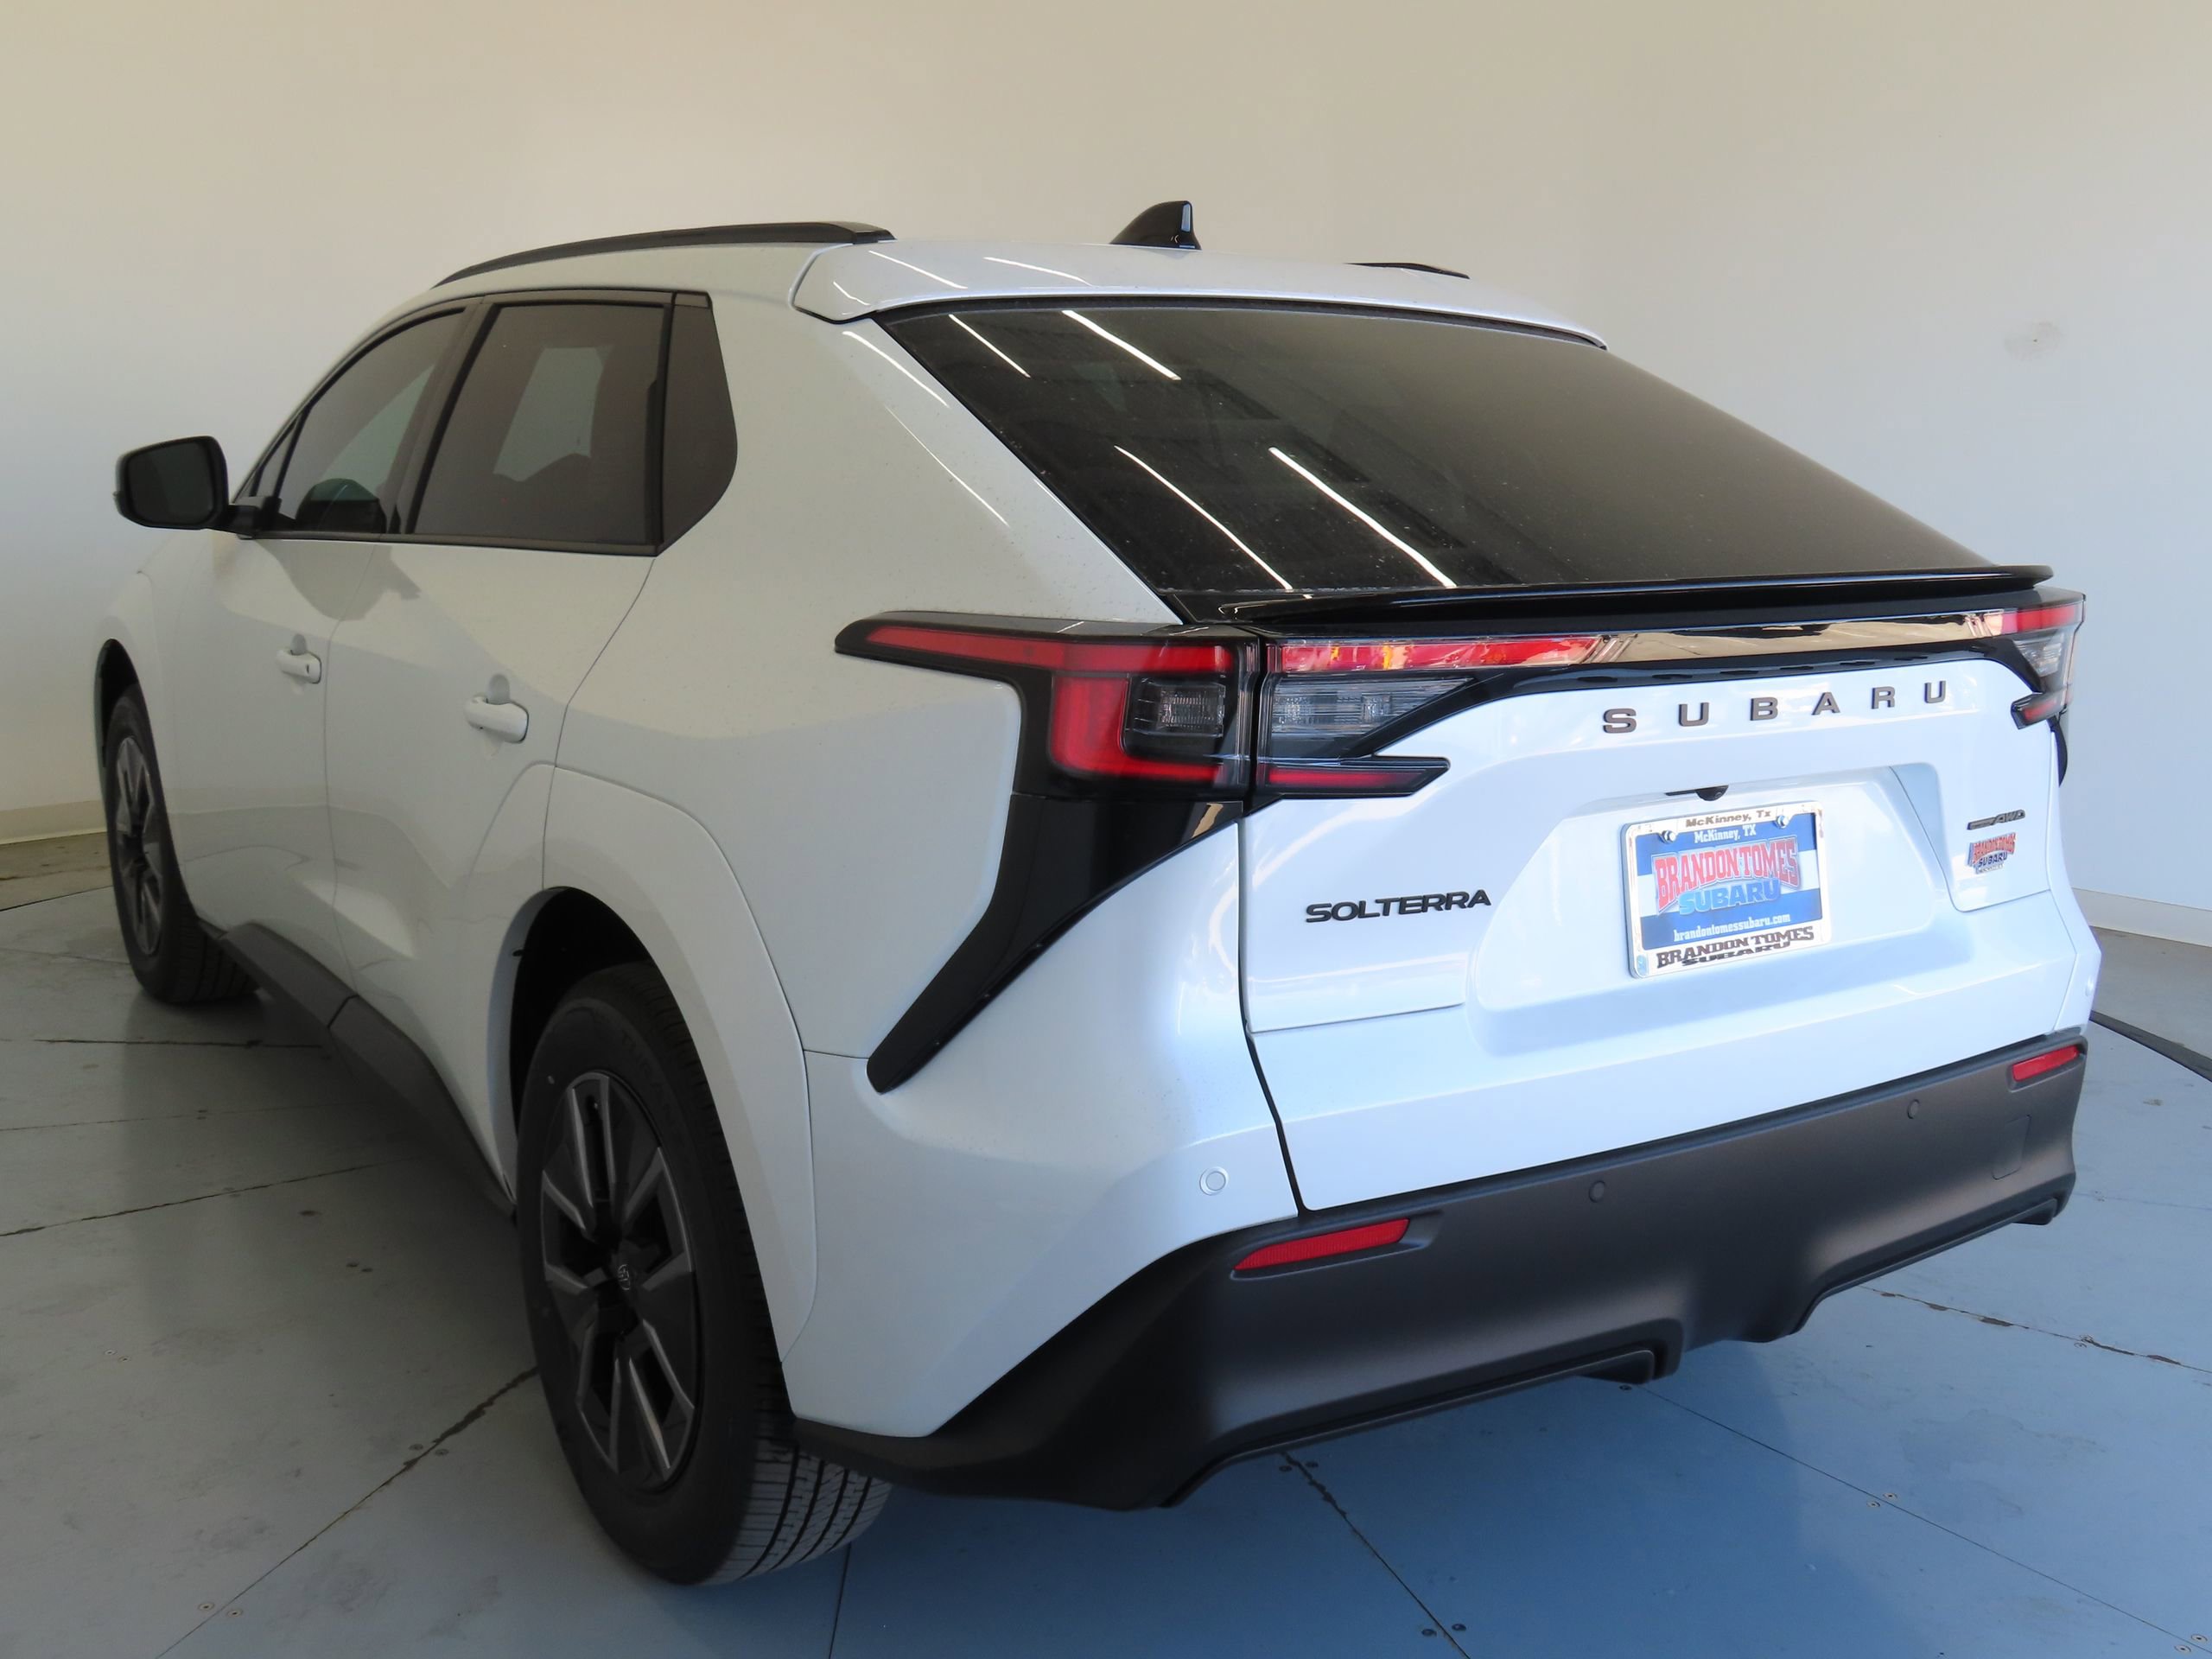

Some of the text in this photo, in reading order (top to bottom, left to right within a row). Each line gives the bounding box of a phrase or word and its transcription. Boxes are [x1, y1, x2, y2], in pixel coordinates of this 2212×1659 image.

[1603, 680, 1947, 734] SUBARU
[1686, 810, 1771, 828] McKinney, Tx
[1694, 823, 1757, 843] McKinney, TX
[1654, 837, 1799, 910] BRANDON TOMES
[1978, 852, 2007, 868] SUBARU
[1306, 888, 1492, 924] SOLTERRA
[1678, 878, 1781, 915] SUBARU
[1673, 914, 1791, 942] brandontomessubaru.com
[1656, 925, 1815, 969] BRANDON TOMES
[1681, 941, 1790, 967] SUBARU
